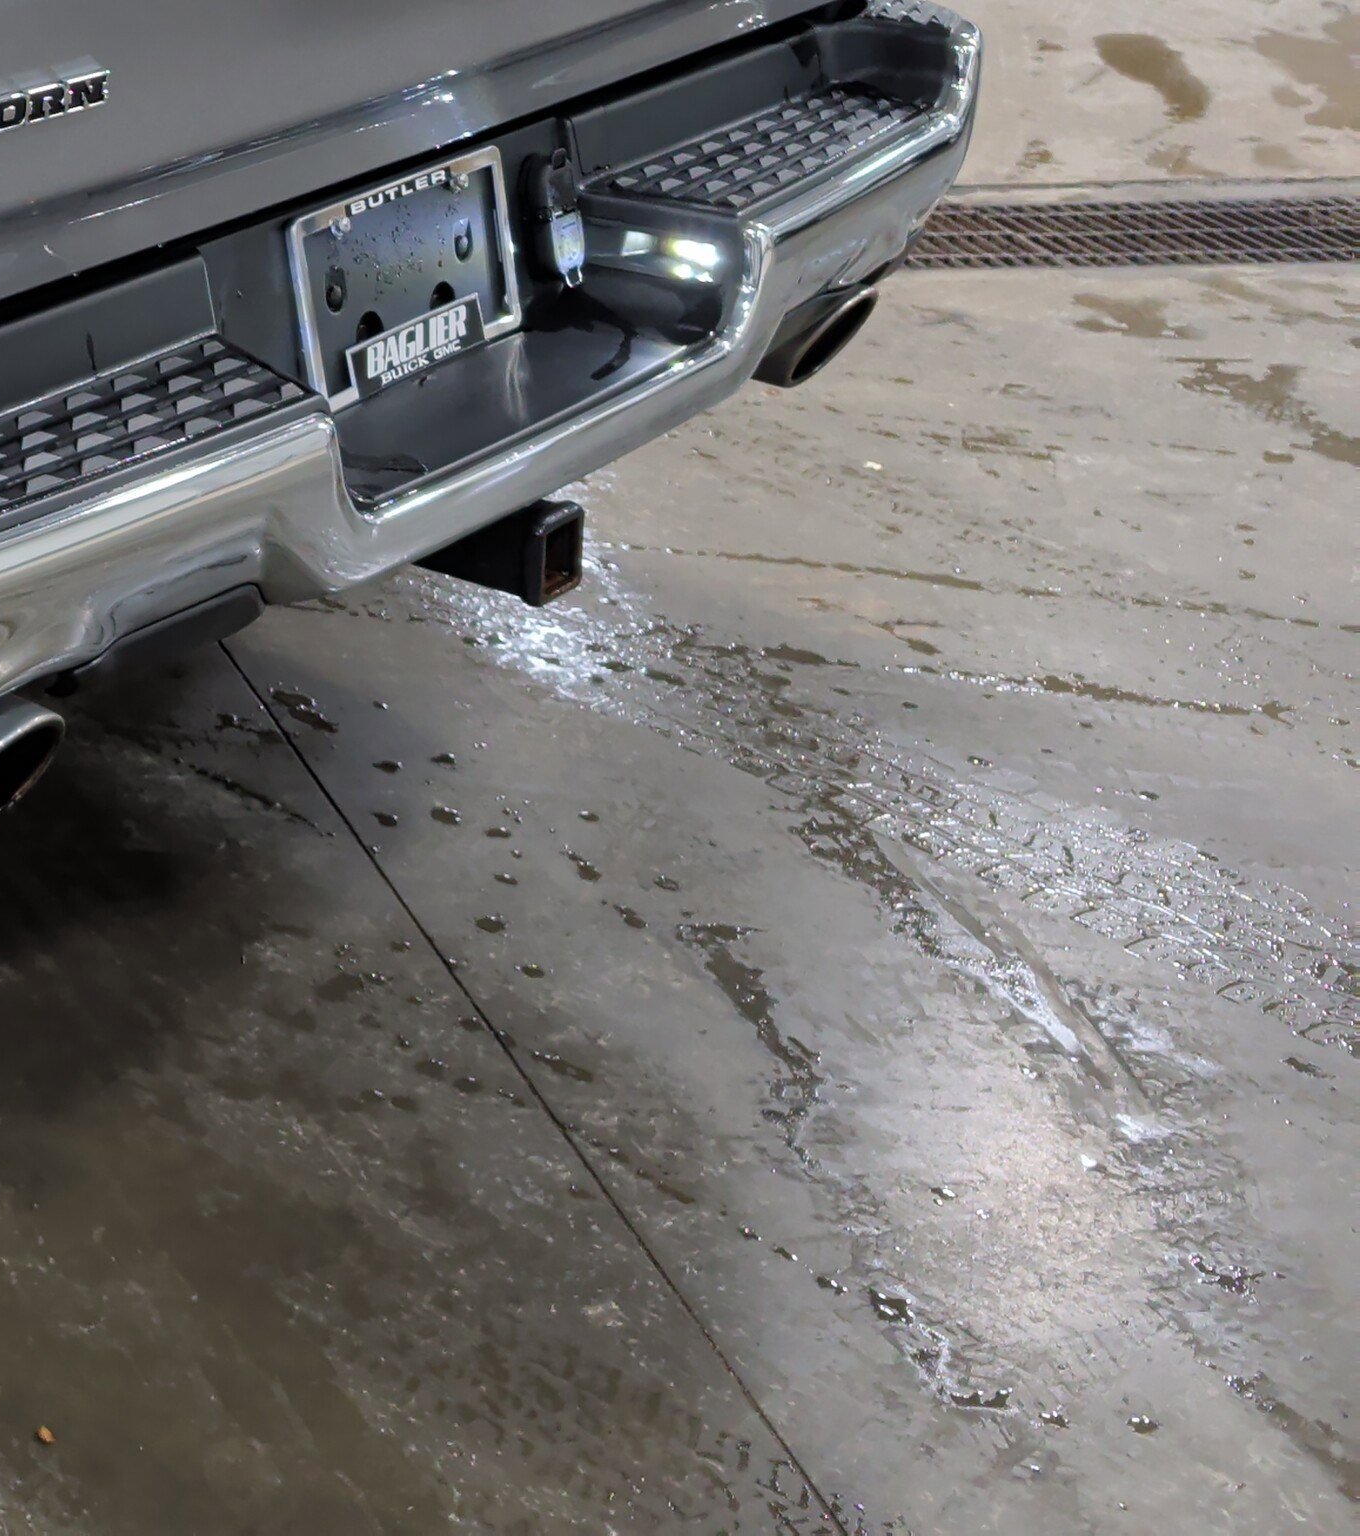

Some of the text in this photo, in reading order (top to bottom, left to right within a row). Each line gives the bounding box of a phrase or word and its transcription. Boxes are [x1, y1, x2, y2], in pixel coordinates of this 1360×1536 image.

[350, 168, 446, 216] BUTLER
[366, 304, 467, 379] BAGLIER
[380, 338, 462, 386] BUICK GMC
